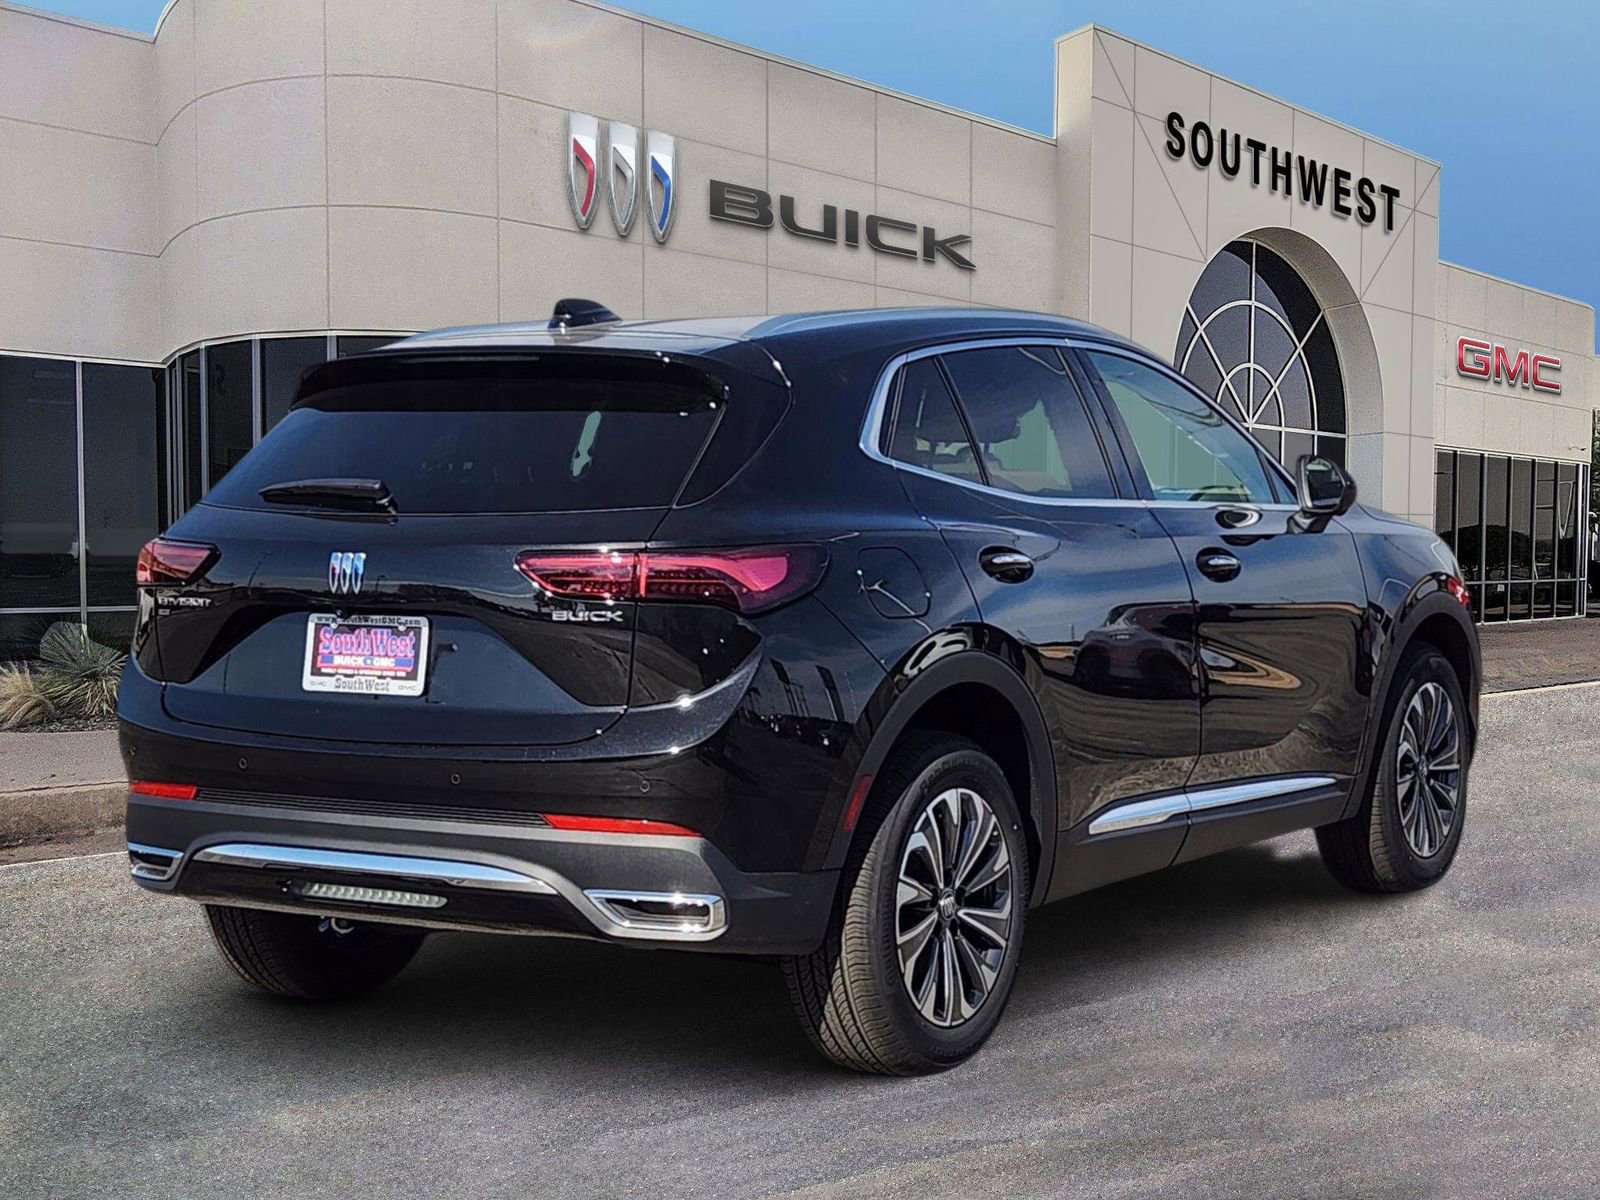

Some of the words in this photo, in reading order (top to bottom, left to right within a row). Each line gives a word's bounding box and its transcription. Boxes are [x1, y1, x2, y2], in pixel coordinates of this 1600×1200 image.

[1165, 111, 1400, 231] SOUTHWEST
[709, 179, 977, 271] BUICK
[1457, 336, 1561, 394] GMC
[552, 611, 623, 622] BUICK
[333, 655, 364, 667] BUICK
[373, 658, 396, 668] GMC
